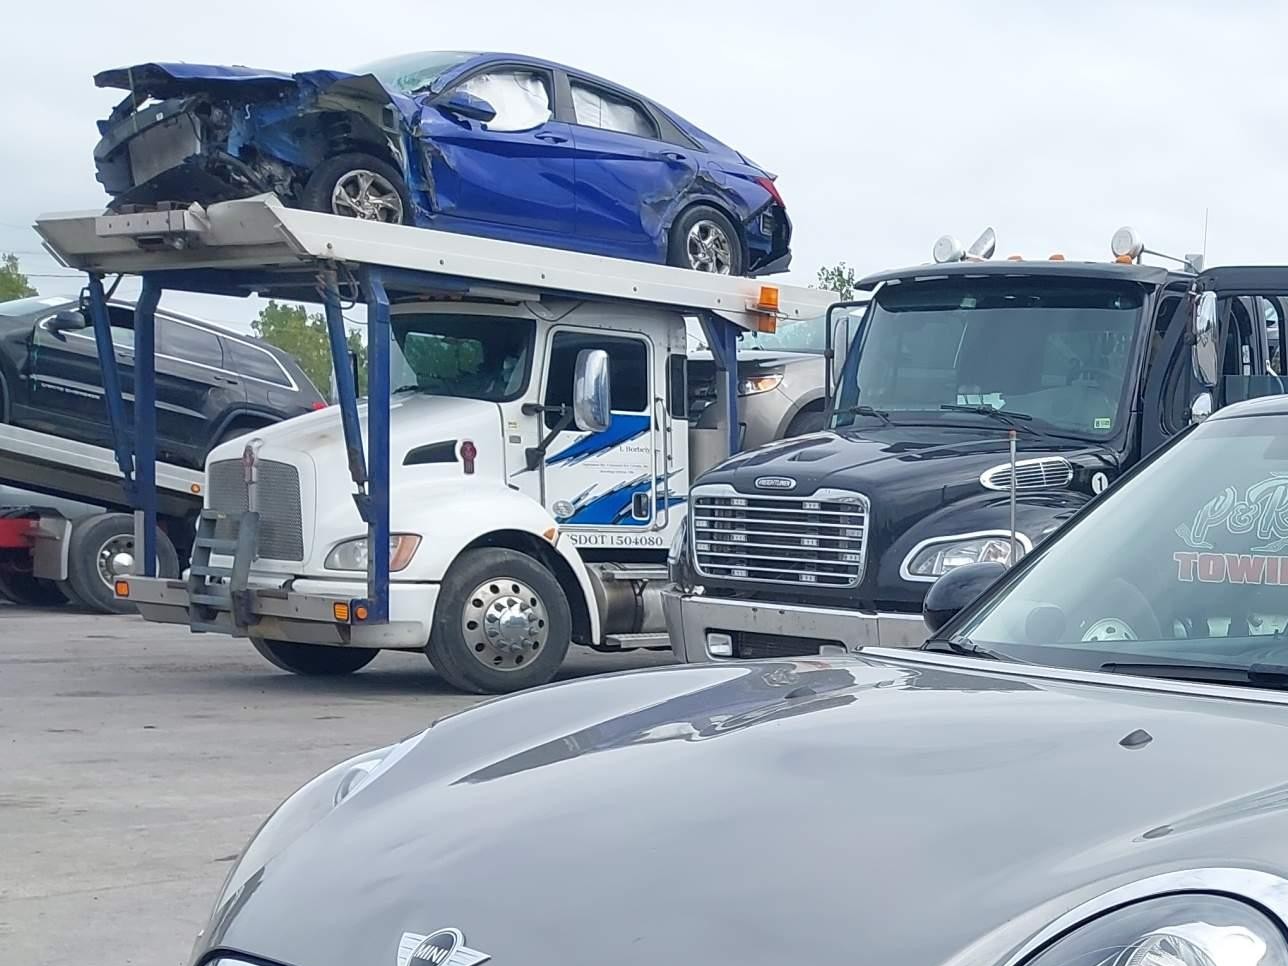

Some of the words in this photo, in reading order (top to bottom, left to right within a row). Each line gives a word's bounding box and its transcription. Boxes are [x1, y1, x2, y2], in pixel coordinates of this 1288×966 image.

[567, 533, 608, 546] SDOT
[610, 535, 663, 546] 1504080
[413, 943, 449, 964] MINI
